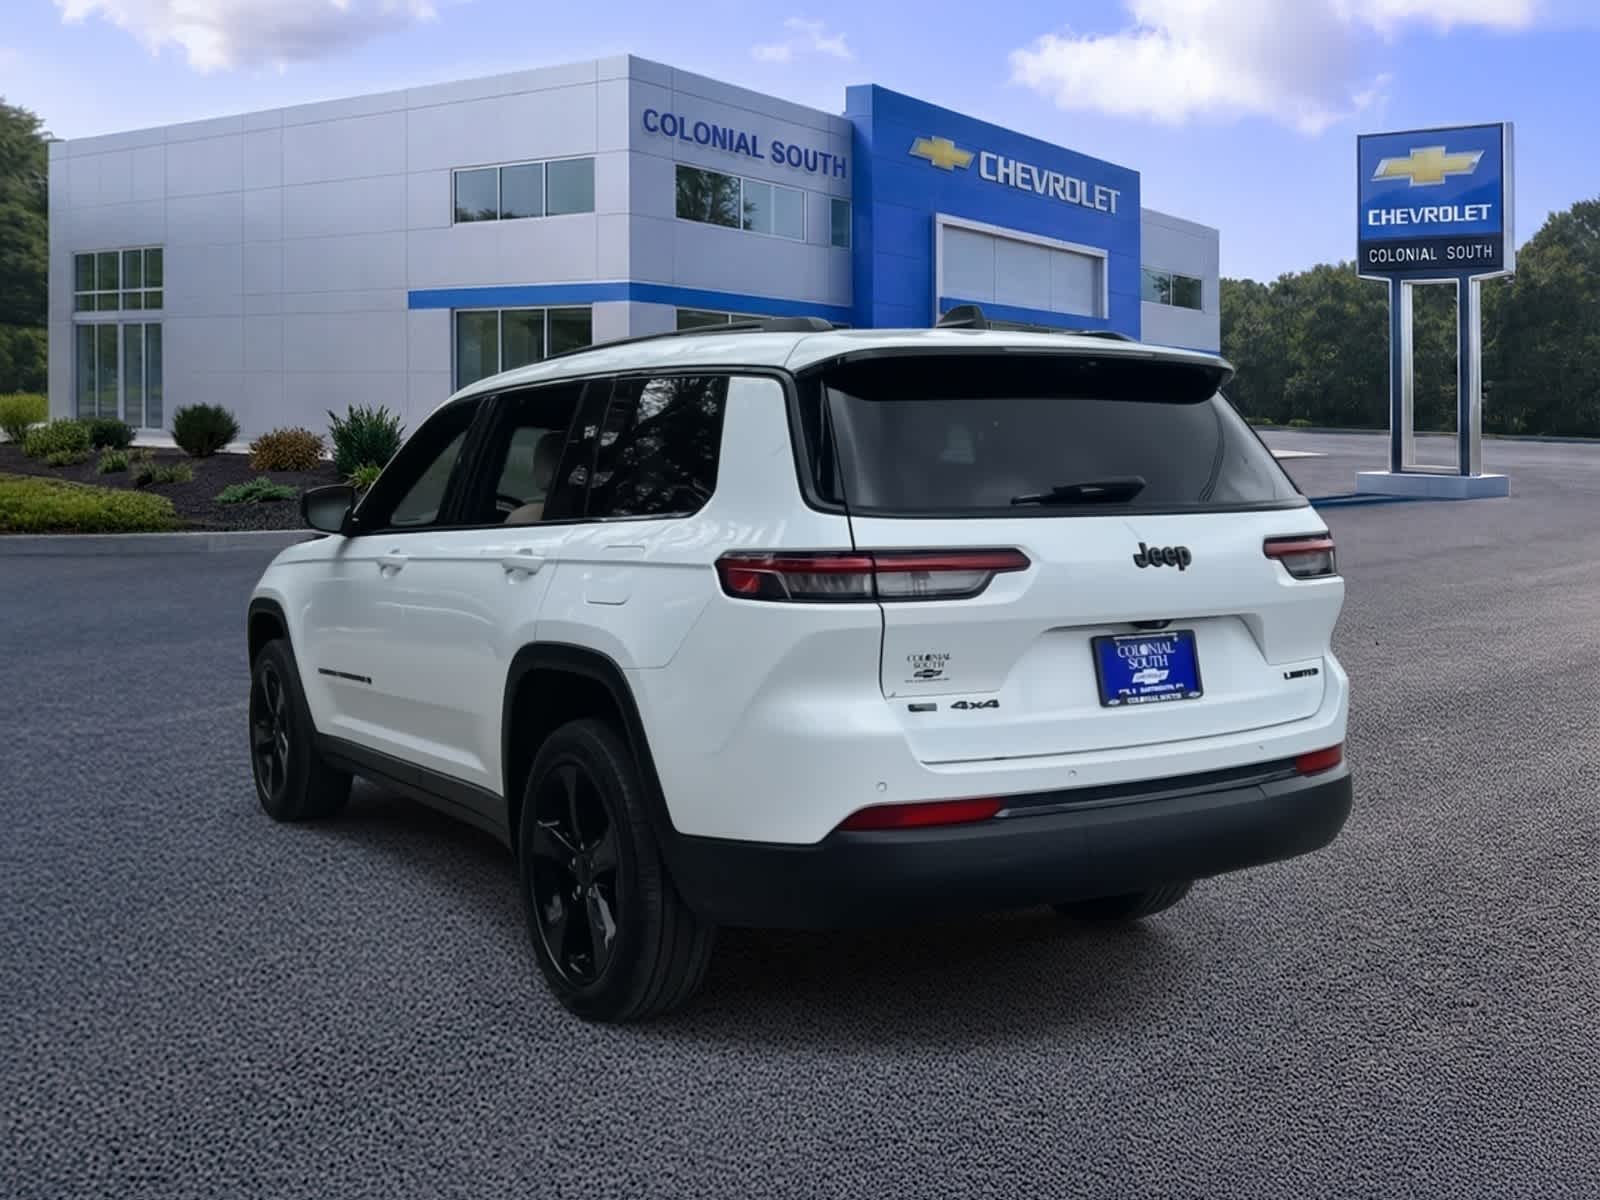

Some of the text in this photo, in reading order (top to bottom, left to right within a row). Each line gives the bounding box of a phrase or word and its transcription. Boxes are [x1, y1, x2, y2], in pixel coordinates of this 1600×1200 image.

[643, 108, 847, 179] COLONIAL SOUTH
[979, 150, 1121, 215] CHEVROLET
[1367, 203, 1493, 226] CHEVROLET
[1368, 244, 1494, 263] COLONIAL SOUTH
[1133, 541, 1192, 571] Jeep
[1117, 642, 1176, 658] COLONIAL
[1128, 655, 1169, 670] SOUTH
